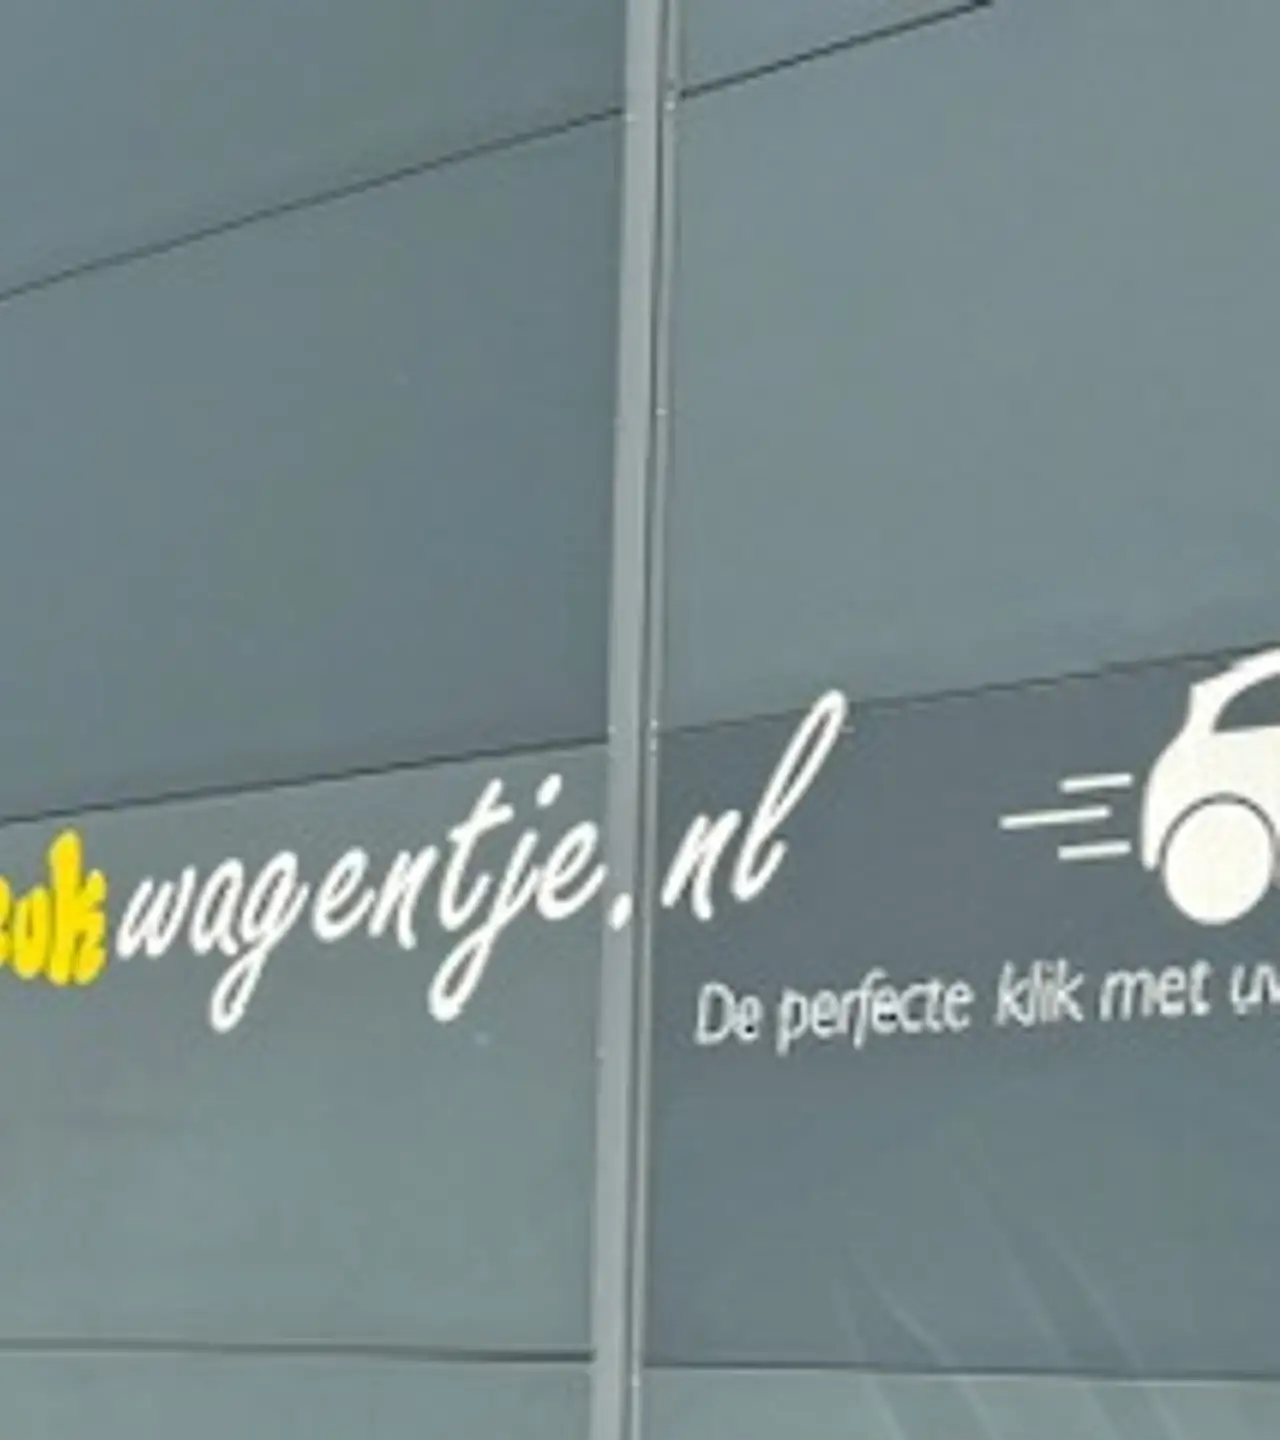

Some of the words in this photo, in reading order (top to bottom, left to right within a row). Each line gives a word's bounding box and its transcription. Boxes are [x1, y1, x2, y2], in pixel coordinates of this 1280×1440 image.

[695, 982, 762, 1046] De
[776, 967, 975, 1056] perfecte
[994, 957, 1085, 1028] klik
[1099, 958, 1212, 1021] met
